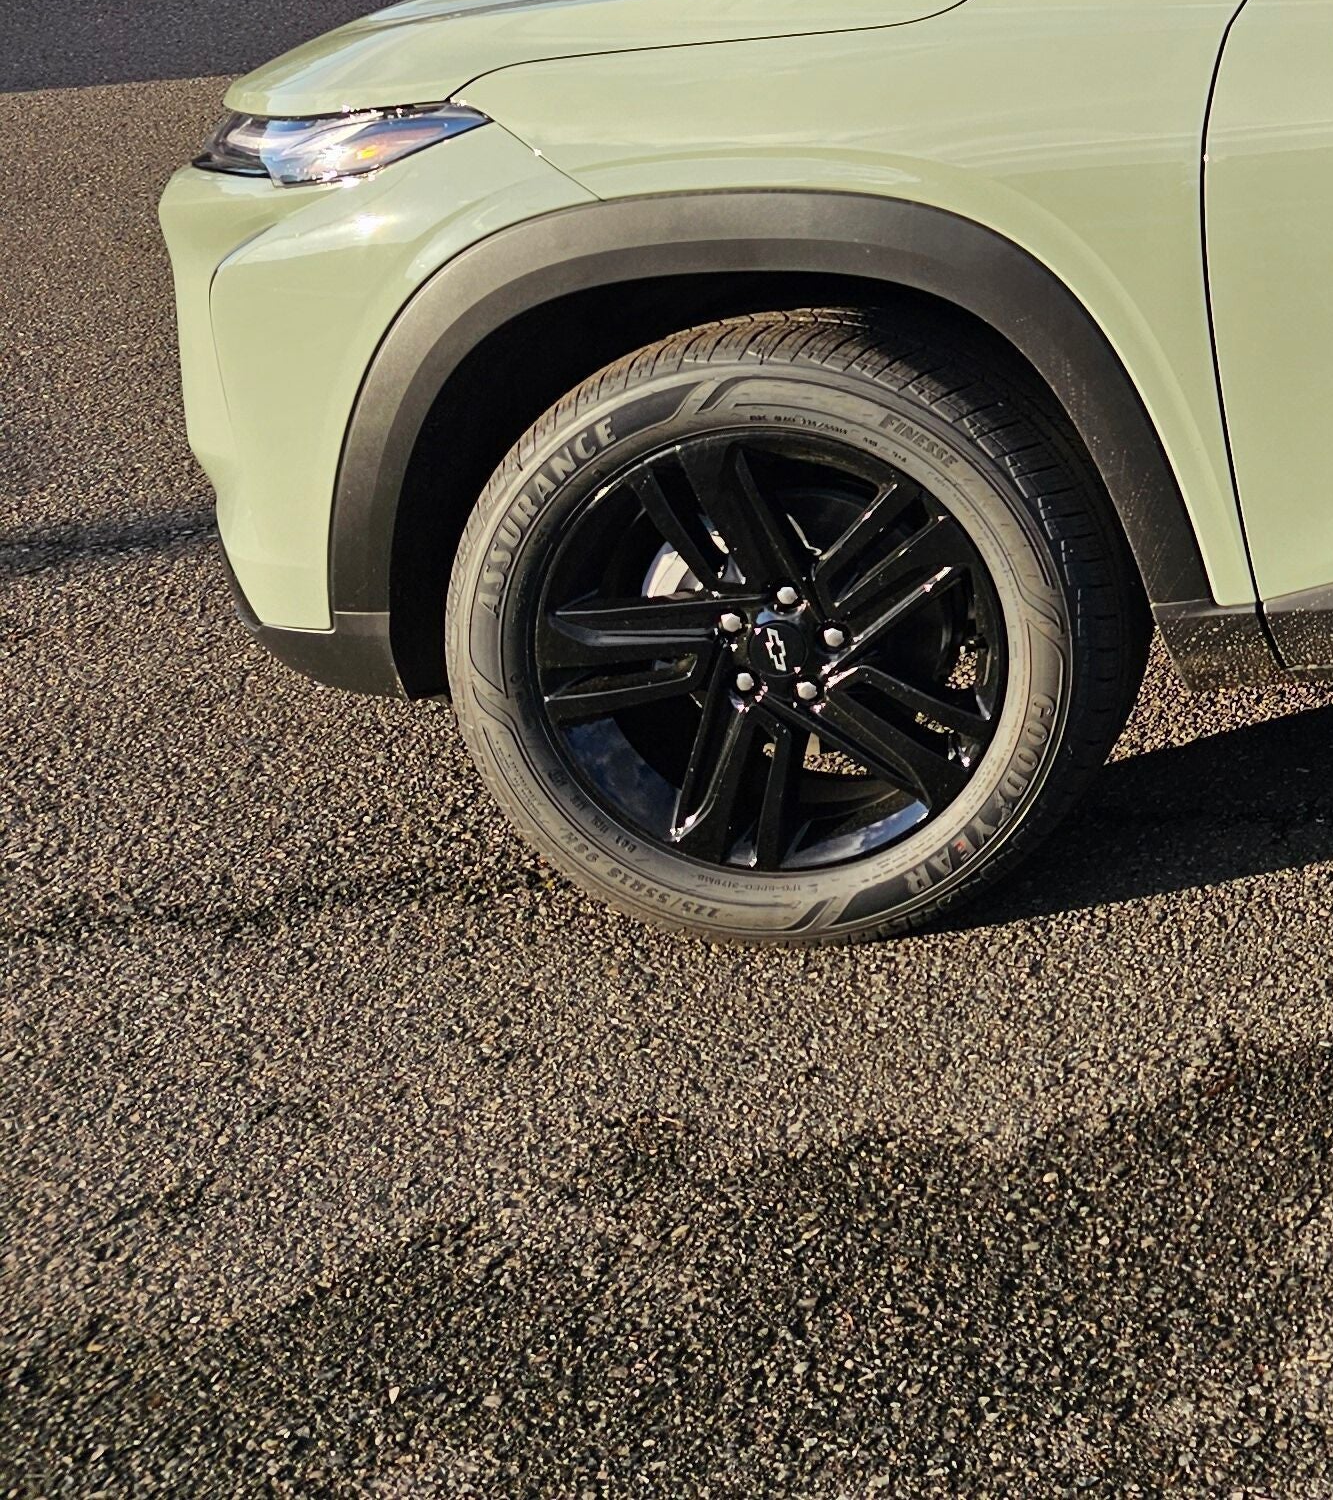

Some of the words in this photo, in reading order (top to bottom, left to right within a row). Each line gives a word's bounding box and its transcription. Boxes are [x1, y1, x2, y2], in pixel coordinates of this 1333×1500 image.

[477, 414, 617, 614] ASSURANCE
[879, 413, 958, 468] FINESSE
[905, 693, 1056, 895] GOODYEAR
